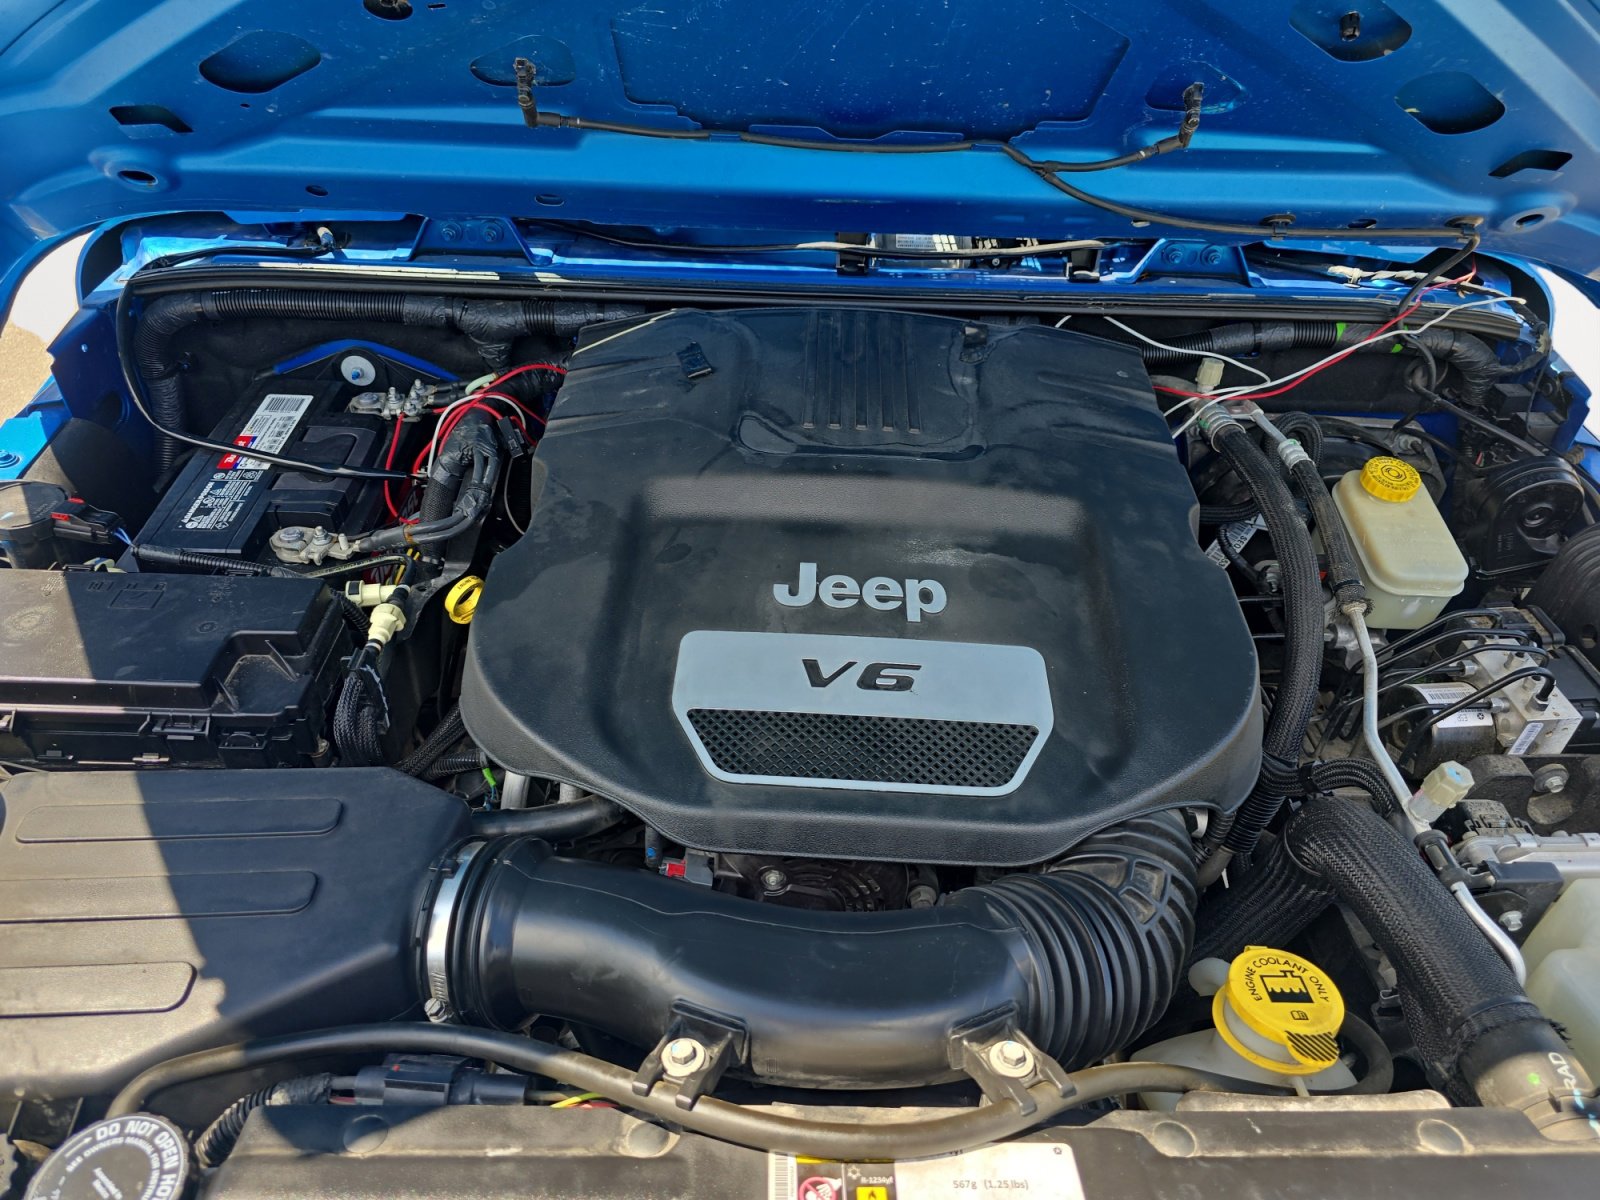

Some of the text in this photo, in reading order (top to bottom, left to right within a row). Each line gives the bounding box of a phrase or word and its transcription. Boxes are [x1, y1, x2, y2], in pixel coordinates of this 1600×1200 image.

[773, 562, 947, 622] Jeep
[802, 658, 922, 692] V6
[1244, 957, 1330, 1002] ENGINE COOLANT ONLY
[95, 1122, 121, 1141] DO
[124, 1120, 159, 1137] NOT
[153, 1131, 179, 1169] OPEN
[952, 1180, 977, 1189] 567g
